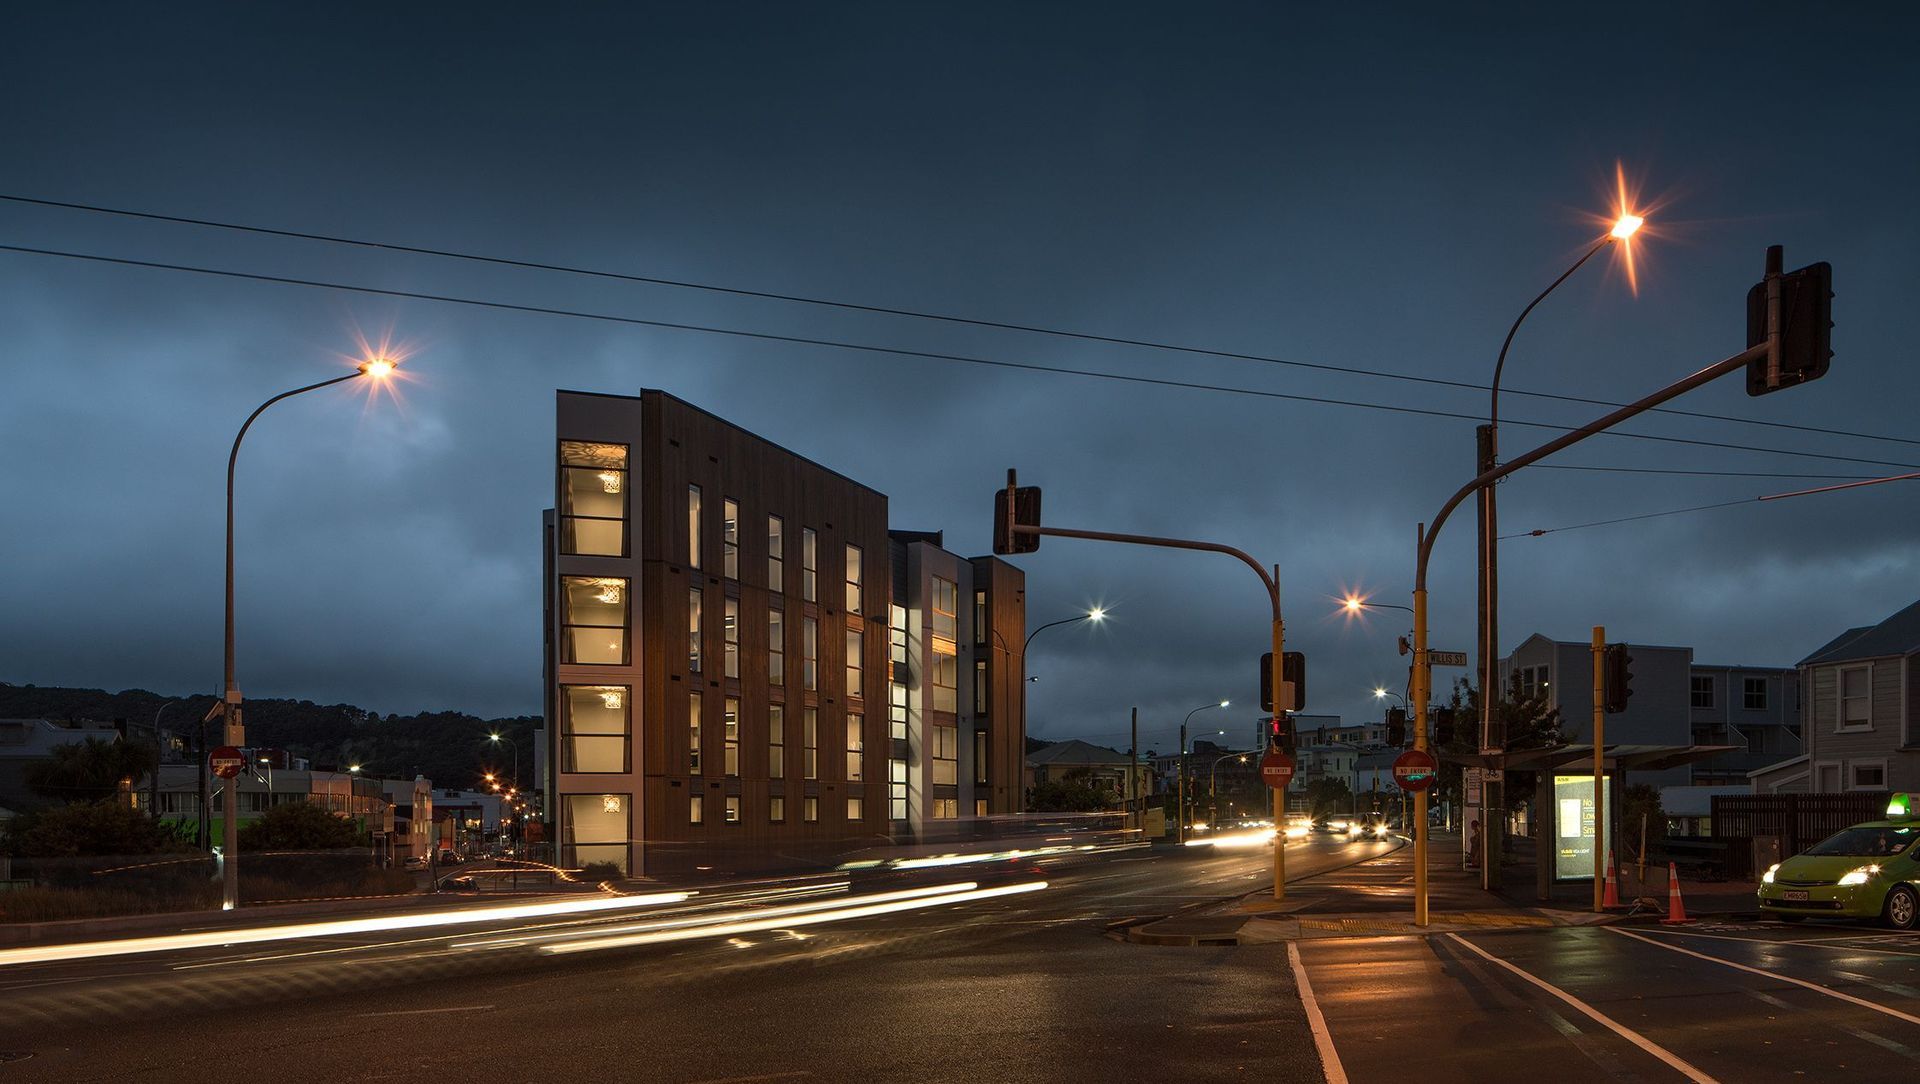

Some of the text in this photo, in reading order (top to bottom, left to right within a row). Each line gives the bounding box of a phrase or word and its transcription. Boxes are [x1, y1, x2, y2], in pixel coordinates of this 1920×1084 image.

[1430, 653, 1464, 664] WILLIS ST
[1582, 799, 1593, 807] No
[1582, 826, 1595, 835] Sm
